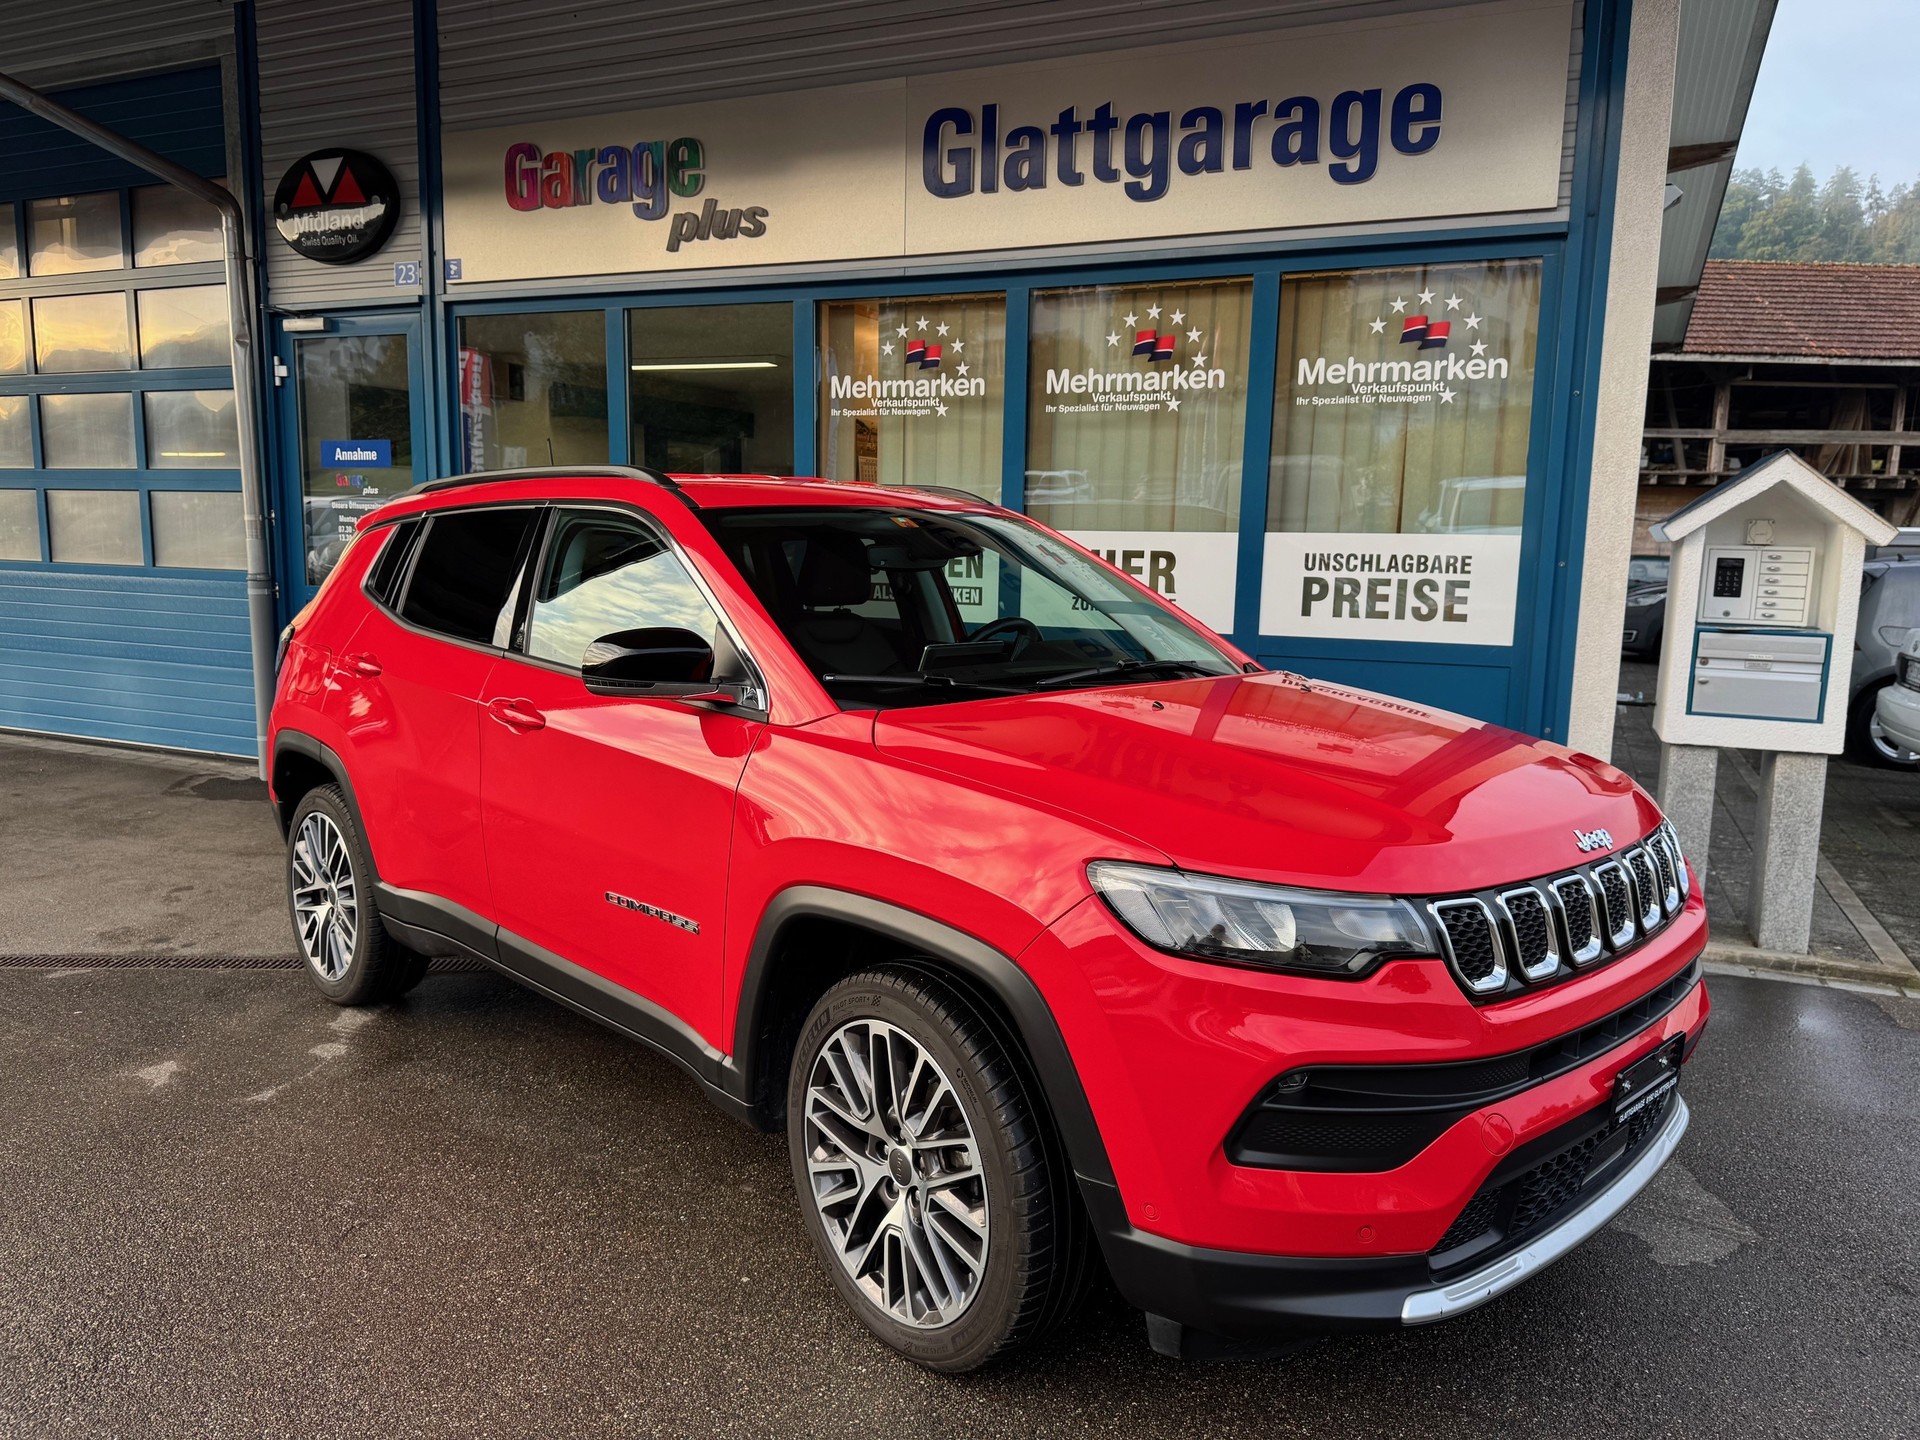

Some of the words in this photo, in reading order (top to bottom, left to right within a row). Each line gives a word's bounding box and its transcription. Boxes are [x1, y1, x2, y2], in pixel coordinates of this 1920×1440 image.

[922, 82, 1443, 203] Glattgarage
[505, 136, 706, 221] Garage
[293, 208, 365, 234] Midland
[666, 198, 769, 253] plus
[301, 236, 321, 247] Swiss
[321, 235, 347, 247] Quality
[398, 265, 415, 285] 23
[1046, 364, 1225, 394] Mehrmarken
[1297, 352, 1509, 385] Mehrmarken
[831, 372, 985, 399] Mehrmarken
[1092, 391, 1172, 403] Verkaufspunkt
[1351, 381, 1445, 394] Verkaufspunkt
[871, 397, 940, 408] Verkaufspunkt
[1045, 404, 1057, 413] Ihr
[1058, 403, 1099, 414] Spezialist
[1100, 403, 1114, 412] für
[1115, 403, 1160, 413] Neuwagen
[1296, 397, 1310, 406] Ihr
[1311, 396, 1359, 406] Spezialist
[1361, 395, 1377, 404] für
[1378, 394, 1431, 404] Neuwagen
[831, 408, 841, 416] Ihr
[842, 408, 878, 417] Spezialist
[879, 408, 890, 416] für
[891, 408, 931, 417] Neuwagen
[335, 447, 377, 461] Annahme
[362, 486, 379, 496] plus
[1304, 552, 1473, 574] UNSCHLAGBARE
[1301, 576, 1471, 623] PREISE
[1572, 828, 1614, 853] Jeep
[604, 891, 700, 935] COMPASS
[794, 1008, 829, 1085] MICHELIN
